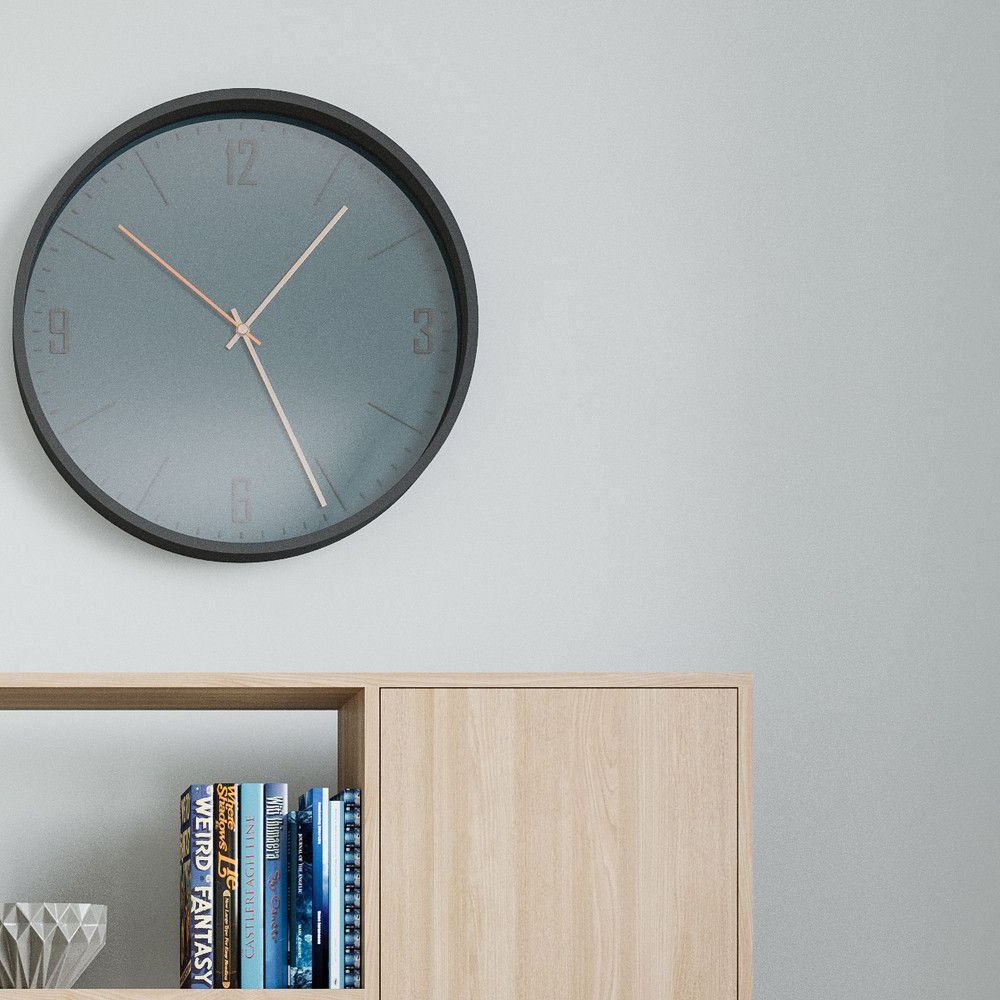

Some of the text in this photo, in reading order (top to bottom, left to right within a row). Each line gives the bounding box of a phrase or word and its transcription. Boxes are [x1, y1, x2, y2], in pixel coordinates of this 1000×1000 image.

[226, 138, 258, 186] 12
[49, 308, 69, 354] 9
[414, 308, 434, 354] 3
[231, 477, 253, 523] 6
[216, 784, 228, 852] Shadows
[226, 784, 236, 832] Where
[193, 796, 214, 987] WEIRD FANTASY
[217, 852, 239, 891] Lie
